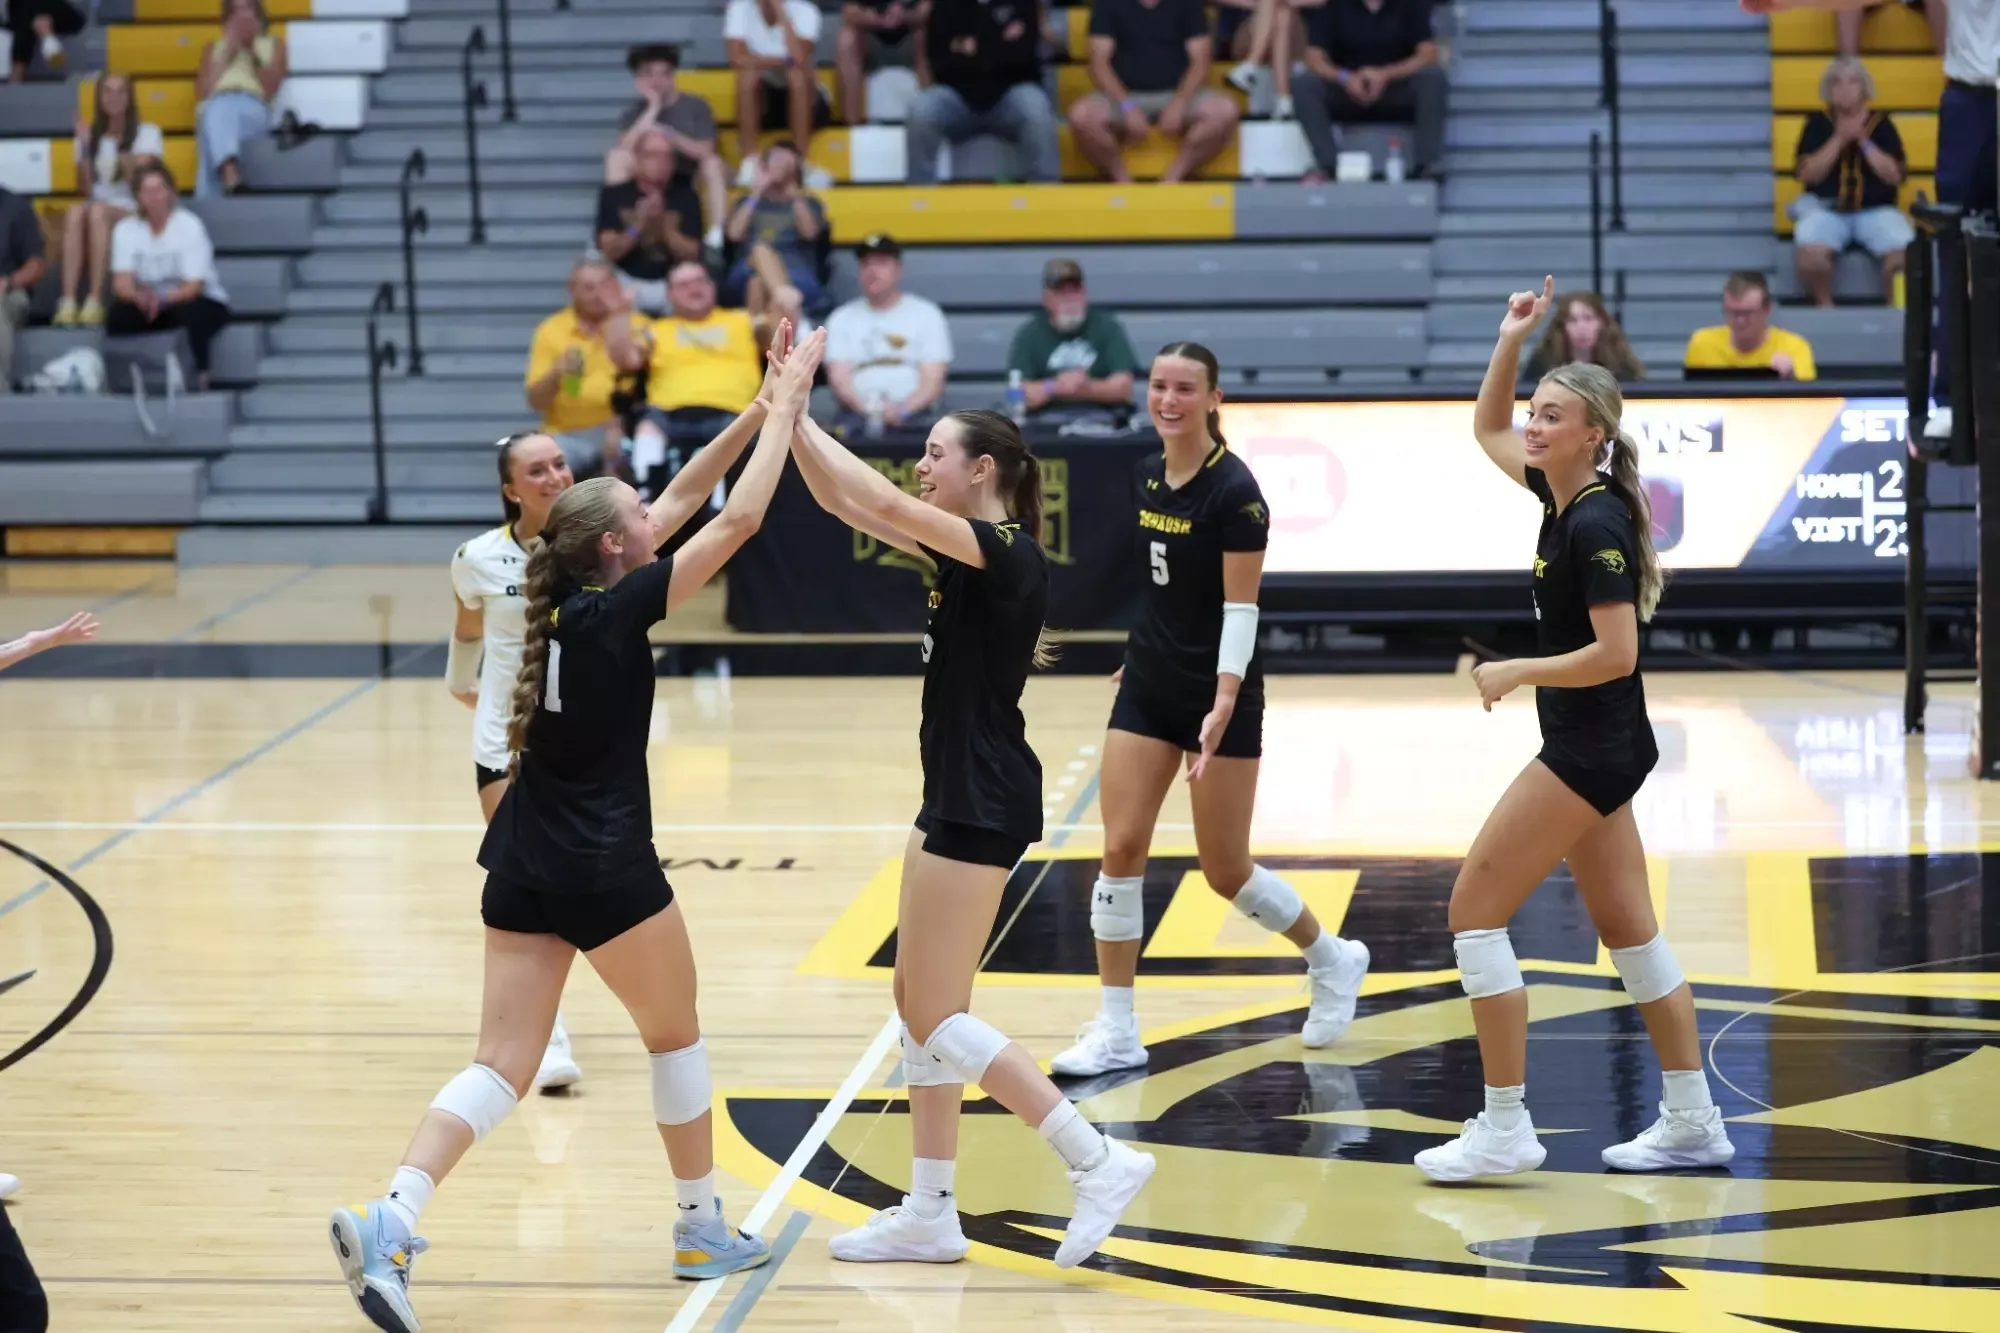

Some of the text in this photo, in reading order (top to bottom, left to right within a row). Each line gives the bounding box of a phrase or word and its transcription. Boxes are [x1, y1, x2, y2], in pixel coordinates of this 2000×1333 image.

[1840, 409, 1909, 442] SET
[1796, 473, 1863, 498] HOME
[1150, 541, 1169, 586] 5
[537, 638, 562, 713] 1
